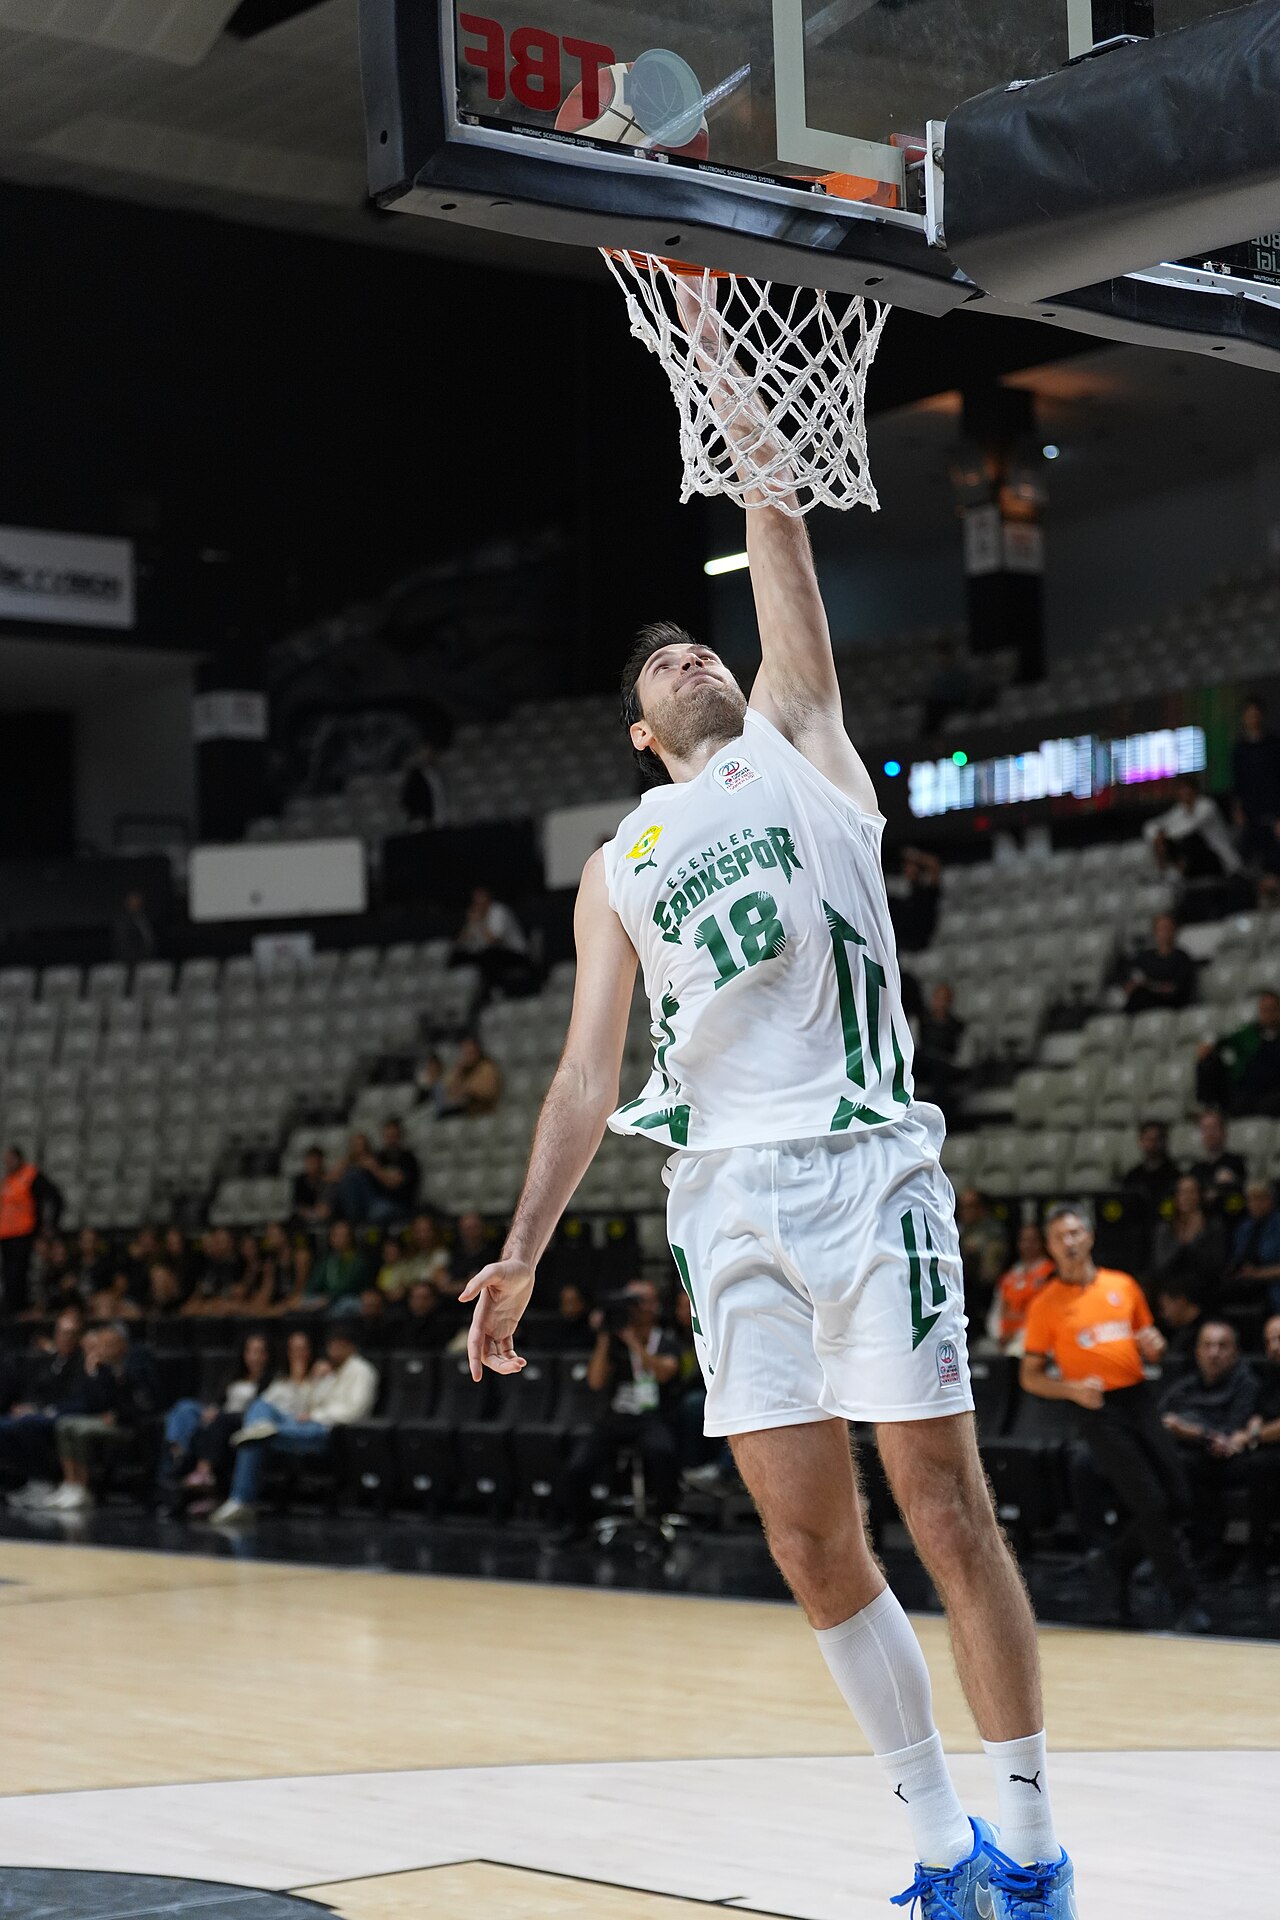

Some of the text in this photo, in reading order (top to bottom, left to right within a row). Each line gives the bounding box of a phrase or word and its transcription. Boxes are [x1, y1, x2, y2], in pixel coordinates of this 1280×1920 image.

[511, 126, 596, 148] NAUTRONIC SCOREBOARD SYSTEM
[698, 163, 776, 185] NAUTRONIC SCOREBOARD SYSTEM
[652, 826, 804, 946] EROKSPOR
[666, 828, 755, 890] ESENLER
[694, 891, 788, 992] 18
